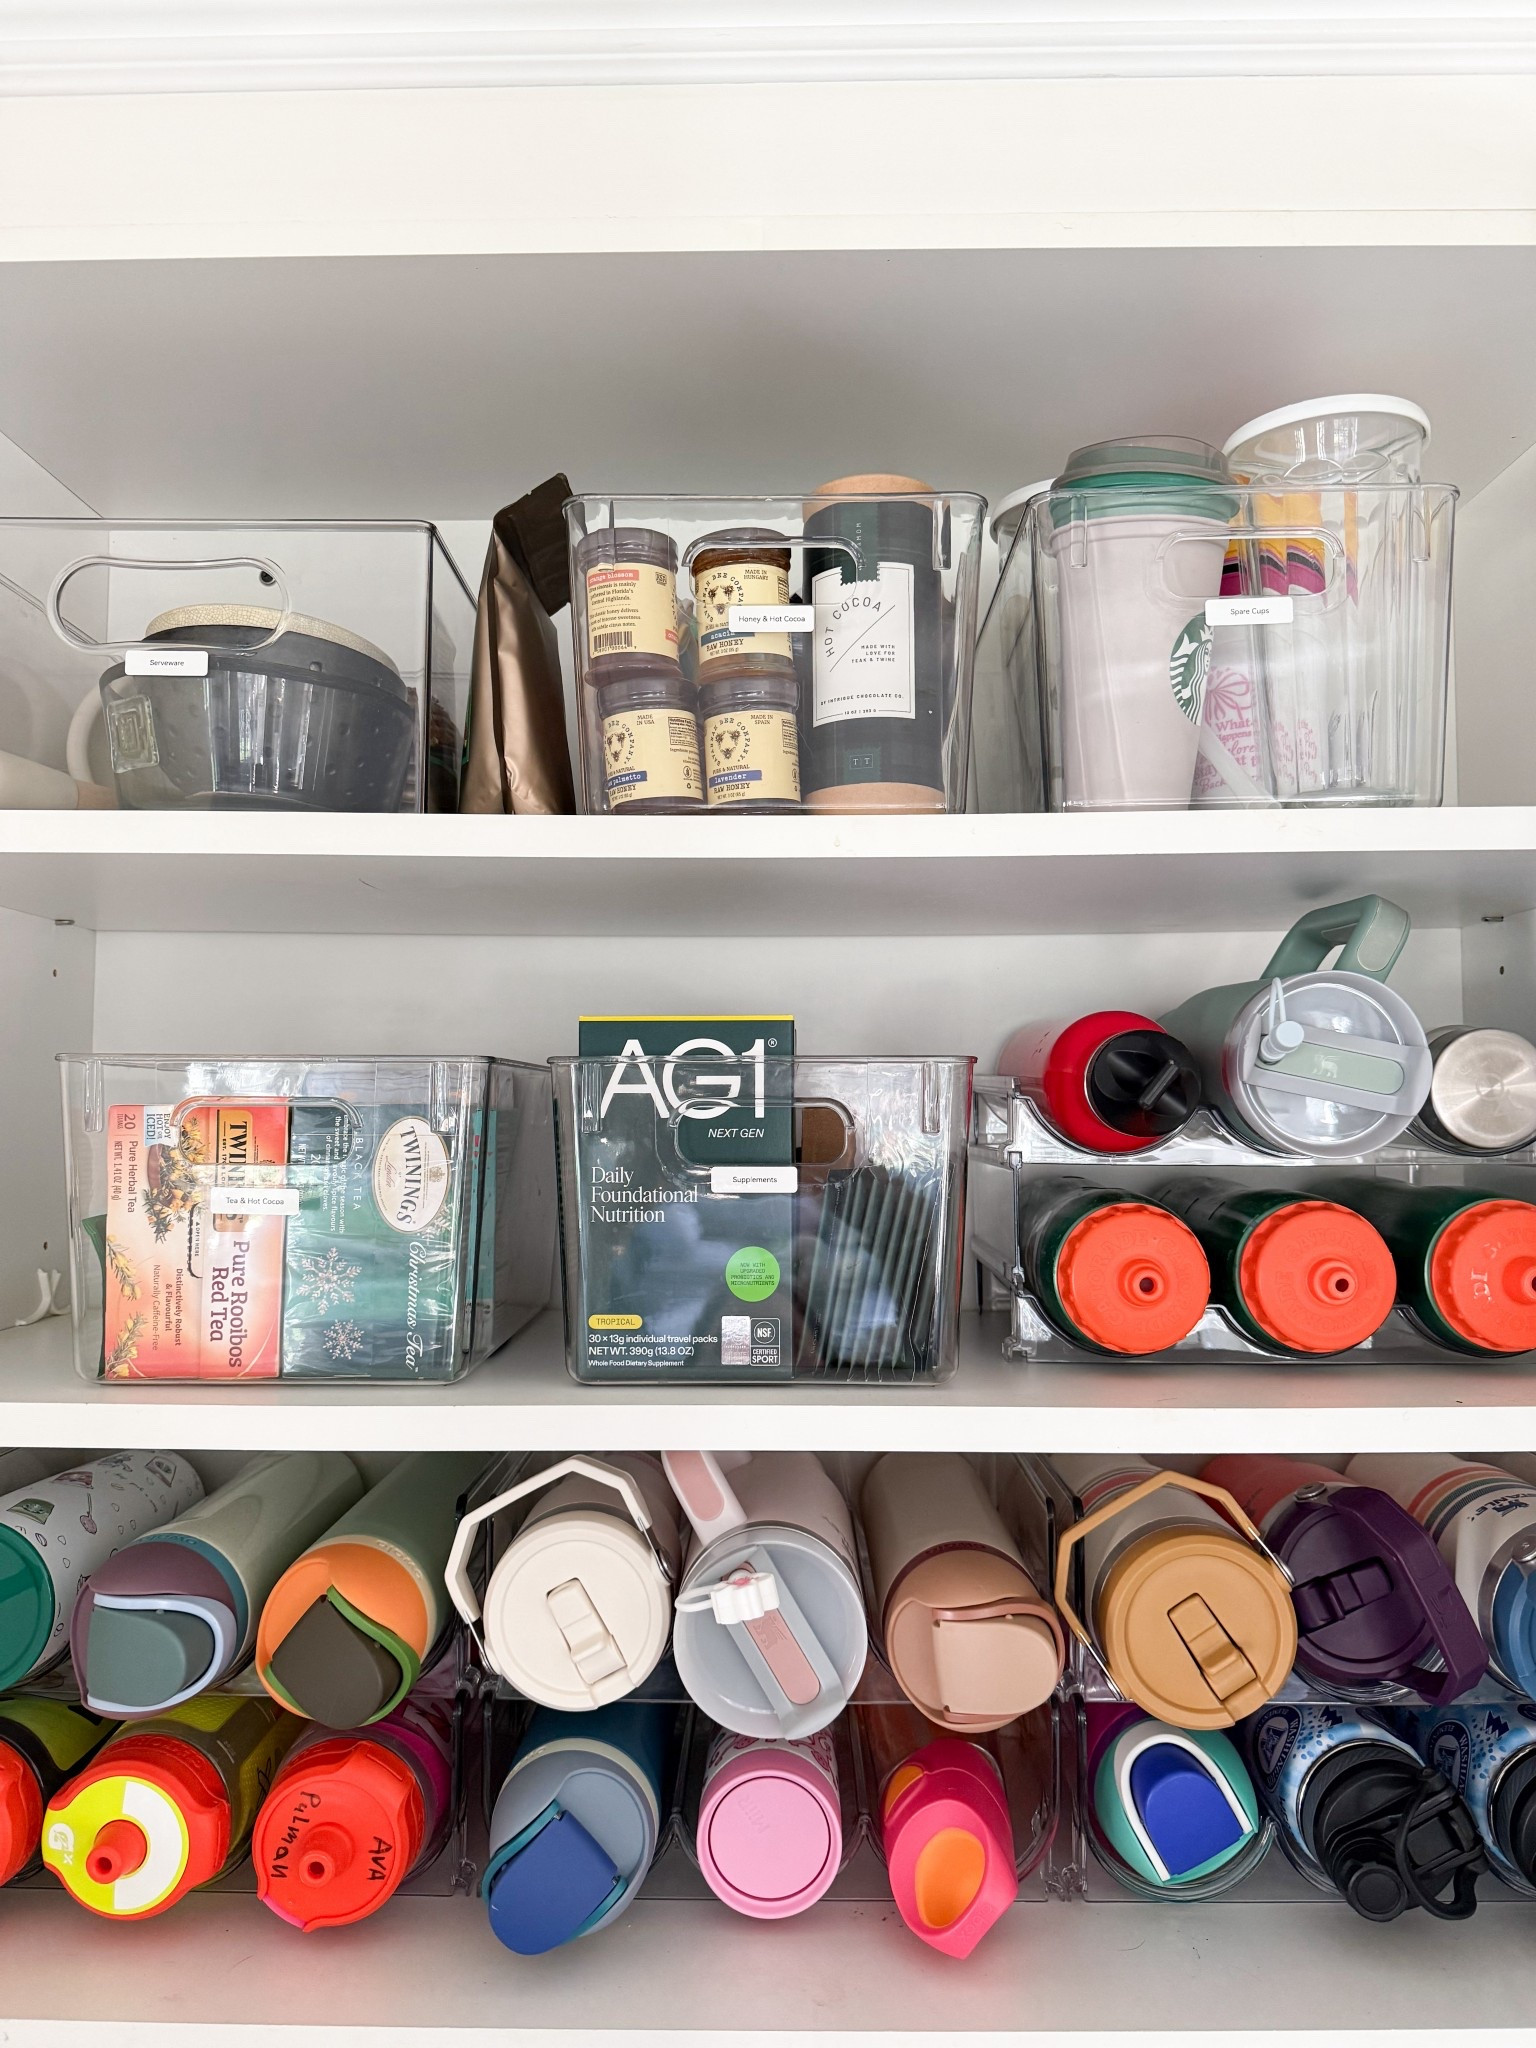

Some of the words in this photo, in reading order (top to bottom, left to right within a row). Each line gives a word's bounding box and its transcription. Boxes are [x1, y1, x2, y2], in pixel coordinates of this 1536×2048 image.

[730, 576, 744, 606] COMPA
[1230, 608, 1250, 616] Spare
[824, 626, 835, 658] HOT
[832, 596, 881, 620] COCOA
[706, 644, 718, 652] RAW
[719, 639, 744, 648] HONEY
[1216, 718, 1250, 732] What
[736, 722, 751, 760] COMPANY
[726, 764, 751, 772] NATURAL
[613, 774, 641, 785] palmetto
[714, 773, 747, 784] lavender
[714, 786, 725, 794] RAW
[726, 782, 751, 792] HONEY
[617, 784, 637, 794] HONEY
[124, 1114, 136, 1130] 20
[146, 1114, 156, 1141] ICED!
[156, 1114, 164, 1130] HOT
[164, 1114, 172, 1139] ENJOY
[326, 1135, 333, 1143] of
[708, 1128, 738, 1138] NEXT
[740, 1128, 765, 1138] GEN
[114, 1140, 123, 1150] NET
[128, 1140, 139, 1162] Pure
[298, 1144, 307, 1154] NET
[352, 1137, 364, 1181] BLACK
[128, 1165, 138, 1195] Herbal
[396, 1126, 422, 1225] TWININGS
[591, 1166, 635, 1188] Daily
[732, 1176, 778, 1185] Supplements
[352, 1186, 362, 1211] TEA
[591, 1186, 699, 1203] Foundational
[128, 1198, 137, 1213] Tea
[590, 1206, 666, 1223] Nutrition
[232, 1240, 250, 1287] Pure
[152, 1264, 161, 1300] Naturally
[211, 1267, 230, 1304] Red
[406, 1241, 427, 1330] Christmas
[174, 1268, 184, 1318] Distinctively
[164, 1292, 173, 1332] Flavourful
[152, 1300, 161, 1351] Caffeine-Free
[210, 1307, 228, 1342] Tea
[228, 1292, 248, 1368] Rooibos
[596, 1318, 636, 1326] TROPICAL
[174, 1318, 183, 1347] Robust
[588, 1334, 601, 1343] 30
[610, 1334, 625, 1345] 13g
[626, 1334, 666, 1343] individual
[668, 1334, 691, 1343] travel
[692, 1334, 718, 1345] packs
[406, 1331, 423, 1370] Tea
[588, 1346, 609, 1356] NET
[609, 1346, 628, 1356] WT.
[630, 1346, 654, 1358] 390g
[655, 1346, 676, 1357] (13.8
[677, 1346, 695, 1357] OZ)
[752, 1356, 779, 1364] SPORT
[625, 1360, 648, 1368] Dietary
[648, 1360, 685, 1368] Supplement
[366, 1836, 393, 1881] AVA
